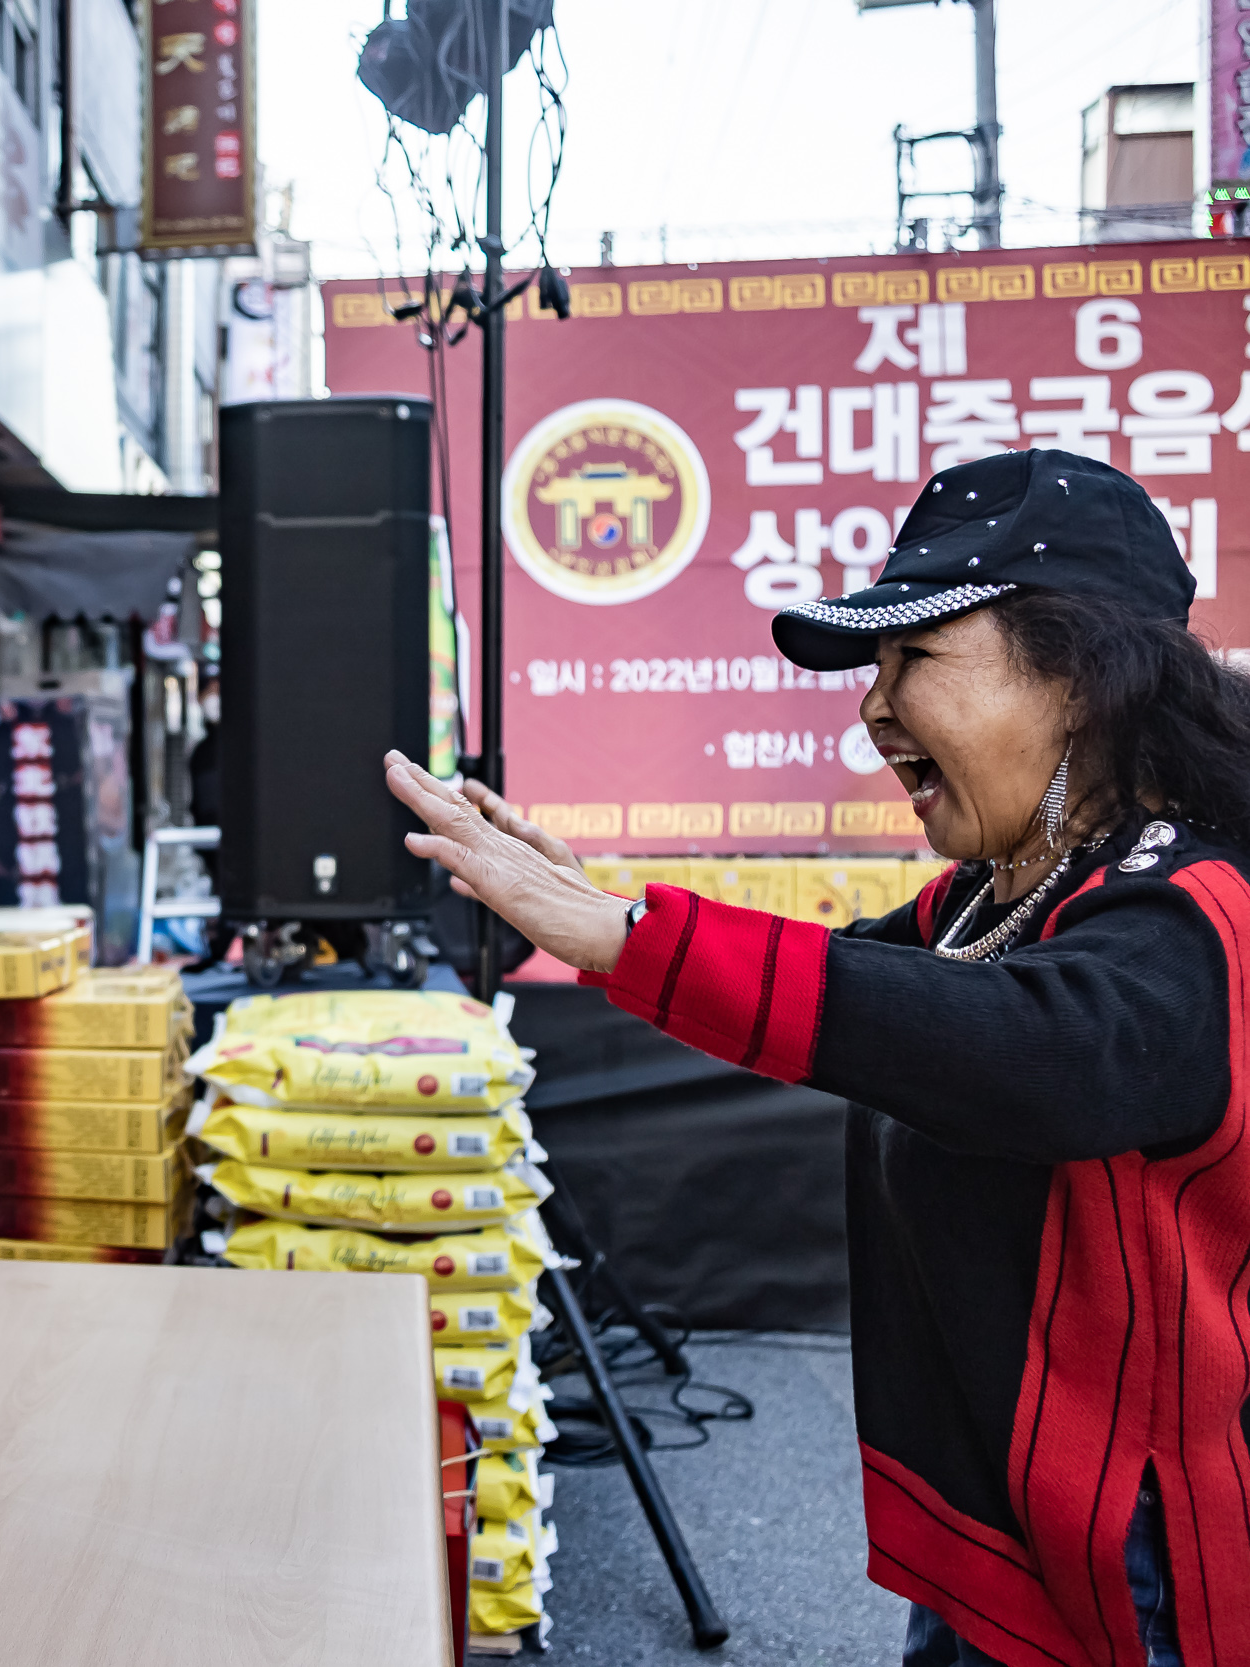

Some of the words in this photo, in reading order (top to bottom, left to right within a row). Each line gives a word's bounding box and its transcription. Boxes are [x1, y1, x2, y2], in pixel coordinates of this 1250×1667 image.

[854, 302, 966, 377] 제
[1075, 298, 1143, 370] 6
[734, 369, 1250, 485] 건대중국음
[527, 657, 586, 697] 일시
